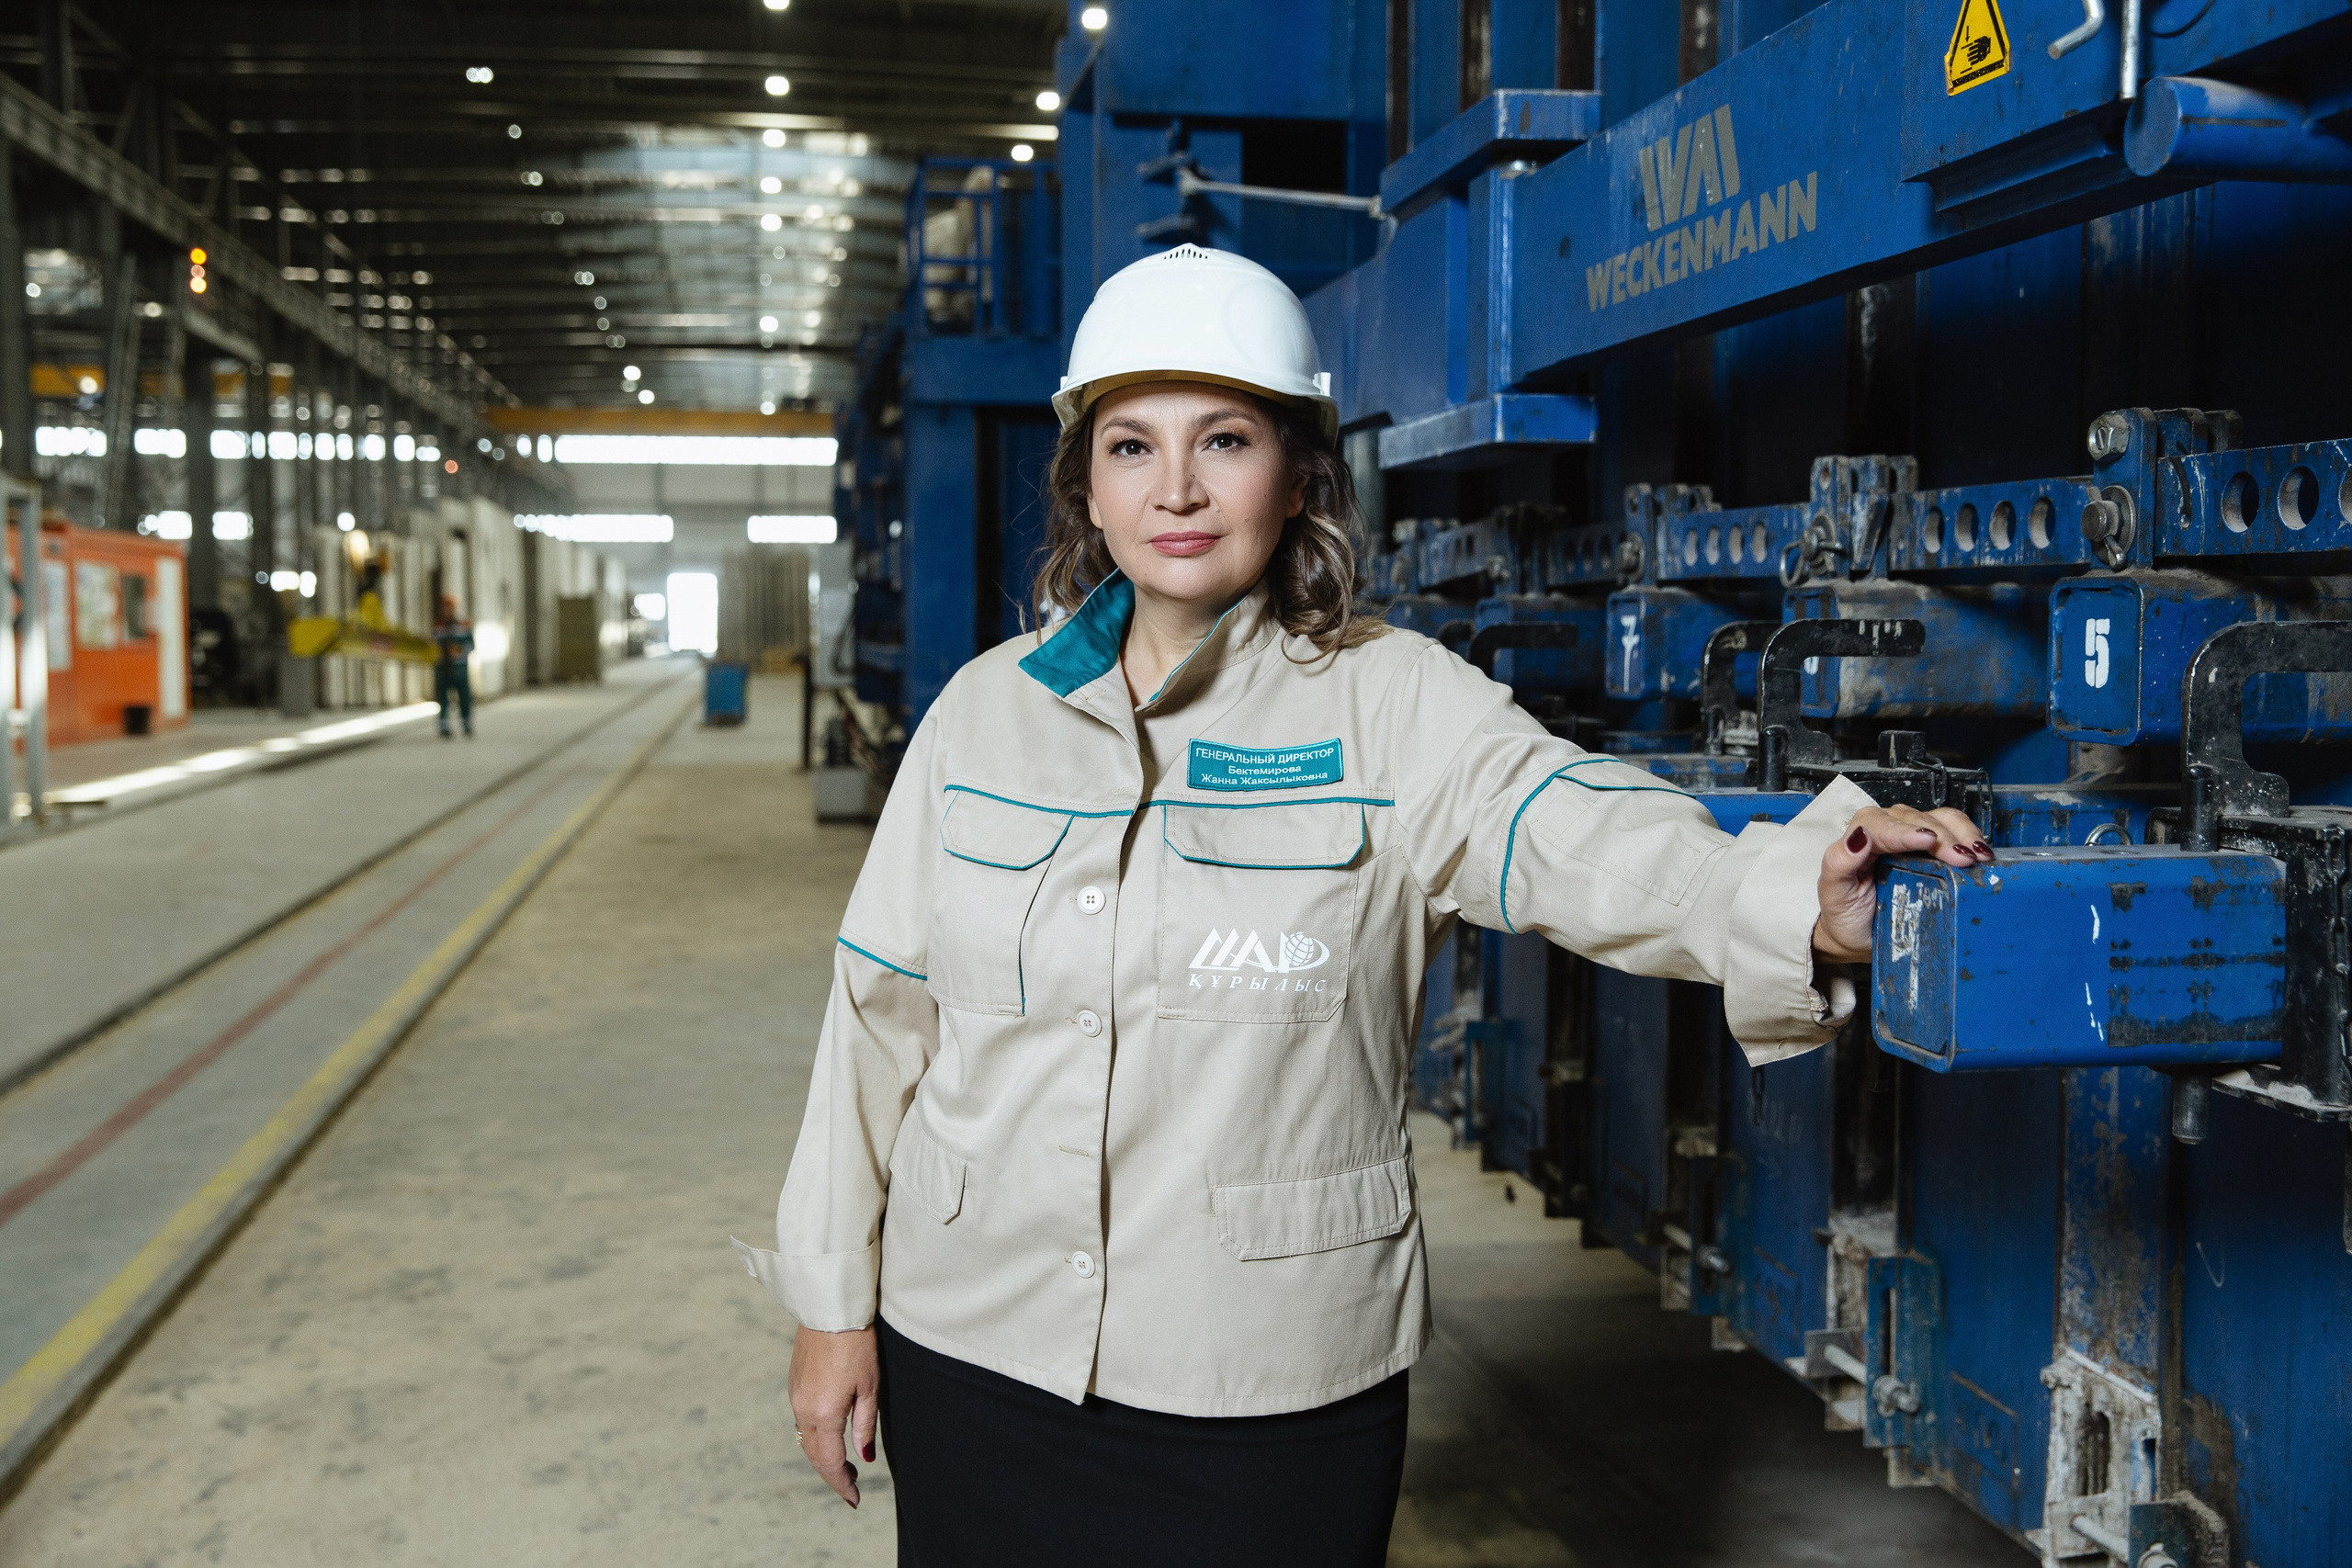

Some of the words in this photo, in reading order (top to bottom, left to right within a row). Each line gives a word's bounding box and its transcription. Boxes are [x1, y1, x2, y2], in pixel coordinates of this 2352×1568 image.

[1586, 171, 1818, 313] WECKENMANN
[2084, 617, 2111, 689] 5
[1195, 748, 1275, 764] ГЕНЕРАЛЬНЫЙ
[1278, 748, 1334, 764] ДИРЕКТОР
[1228, 765, 1302, 775] Бектемирова
[1201, 773, 1238, 785] Жанна
[1240, 773, 1329, 785] Жаксылыковна
